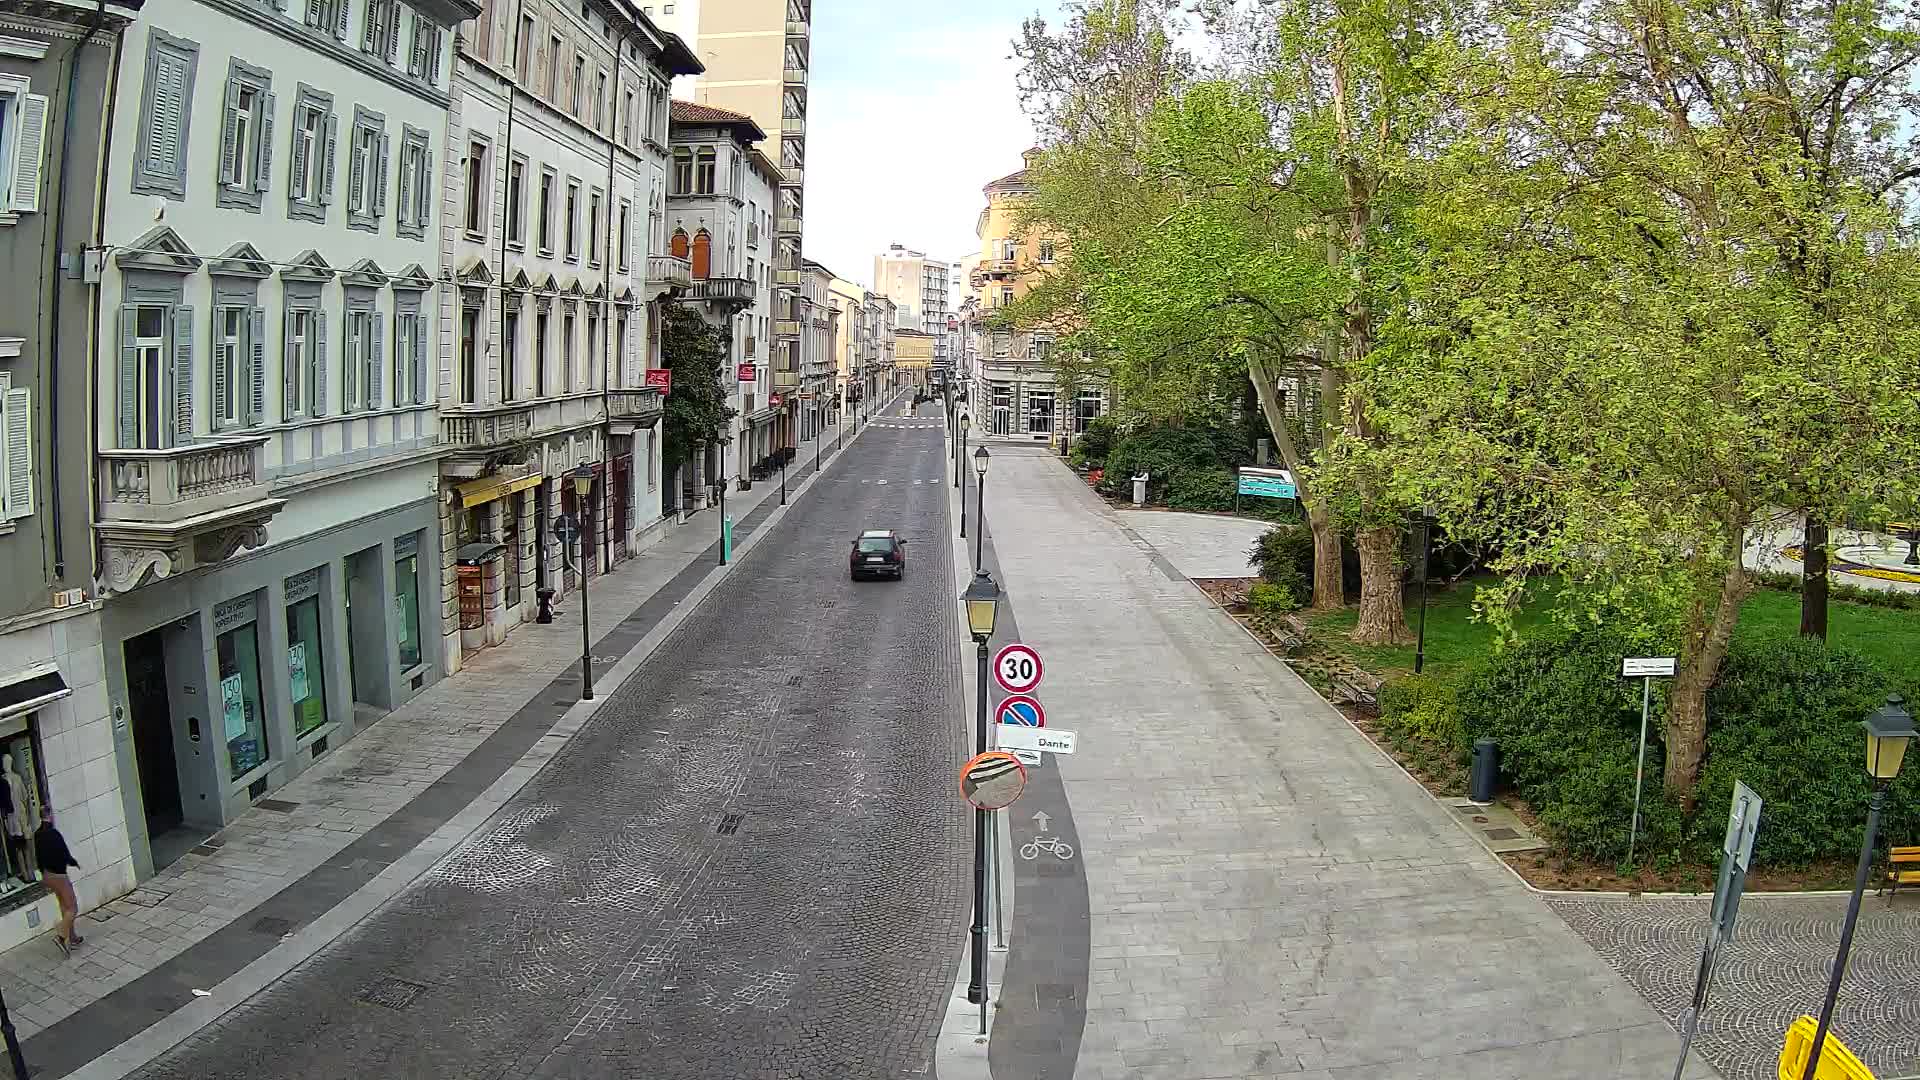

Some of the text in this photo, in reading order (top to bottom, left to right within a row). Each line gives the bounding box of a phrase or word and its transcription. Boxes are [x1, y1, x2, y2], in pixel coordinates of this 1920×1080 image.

[1005, 658, 1033, 680] 30
[222, 677, 240, 700] 130
[1038, 738, 1070, 749] Dante
